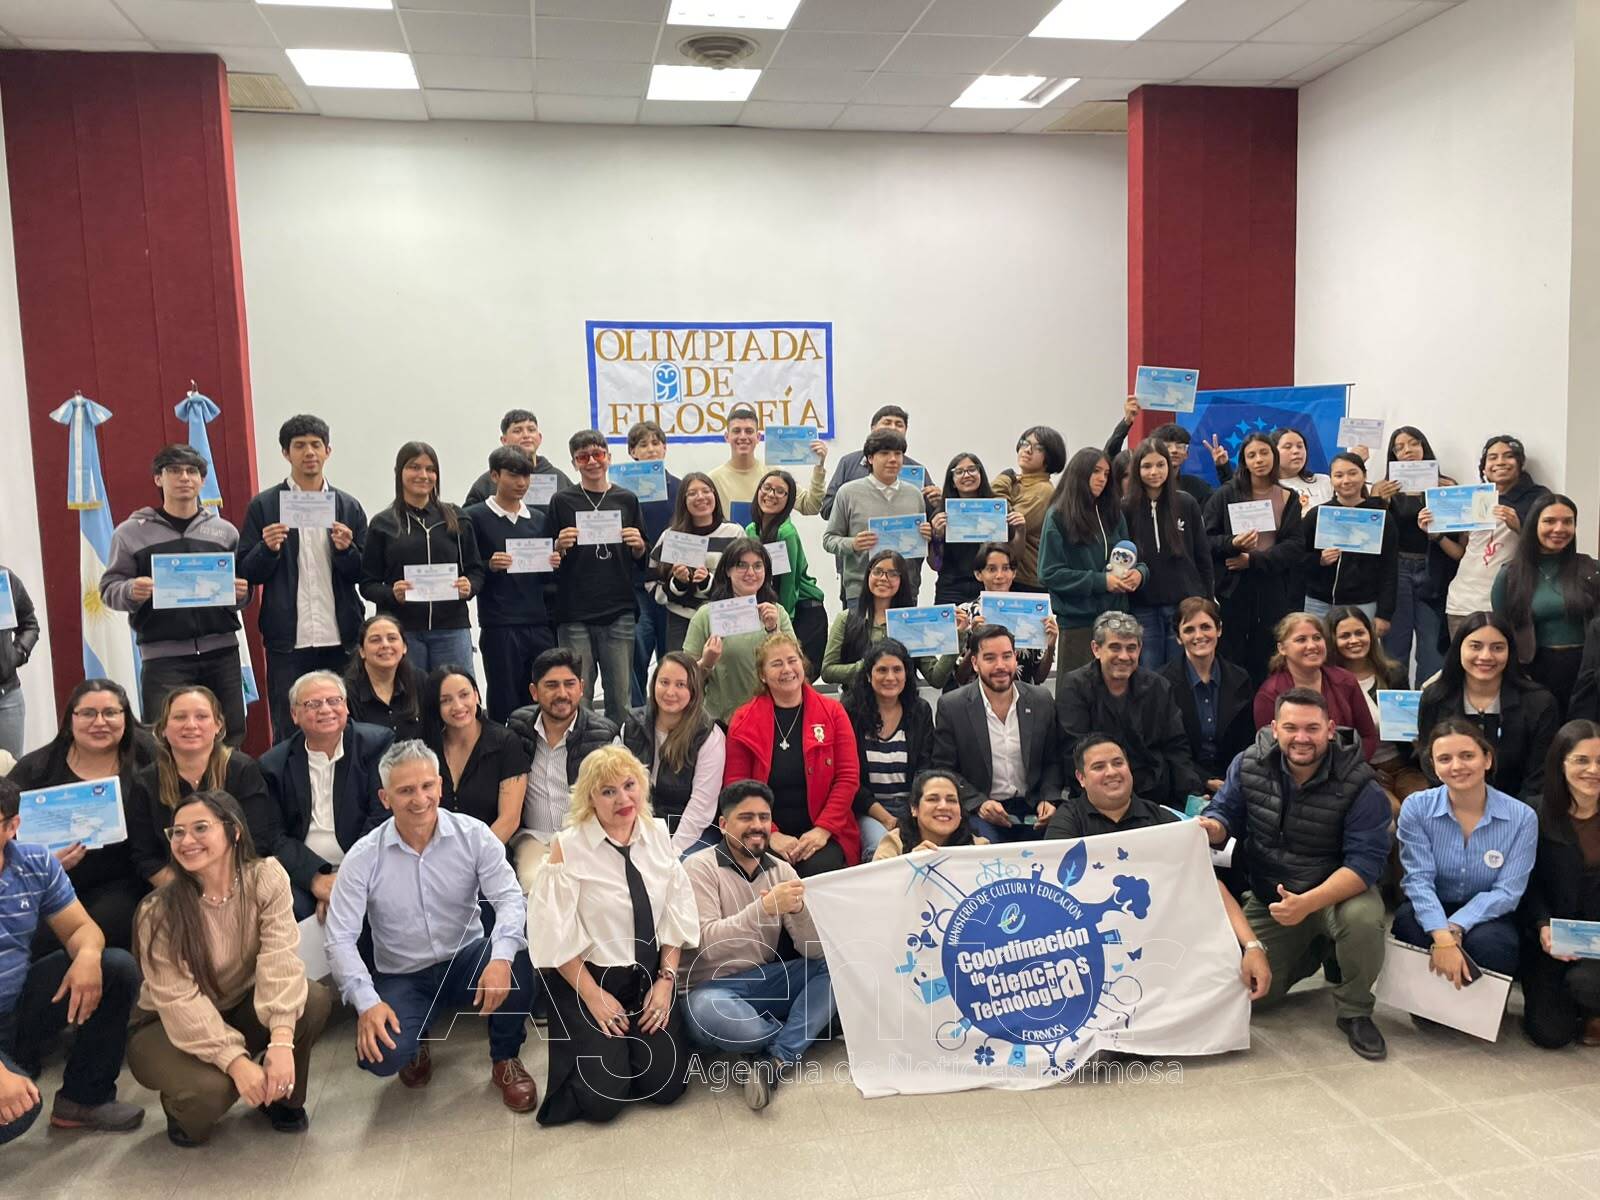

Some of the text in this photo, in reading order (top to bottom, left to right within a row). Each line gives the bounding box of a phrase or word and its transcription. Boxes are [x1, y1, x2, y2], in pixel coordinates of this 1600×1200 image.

[595, 329, 824, 362] OLIMPIADA
[682, 366, 734, 397] DE
[948, 882, 1084, 947] MINISTERIO DE CULTURA Y EDUCACIÓN
[957, 927, 1090, 973] Coordinación
[970, 972, 986, 986] de
[1022, 1023, 1069, 1041] FORMOSA
